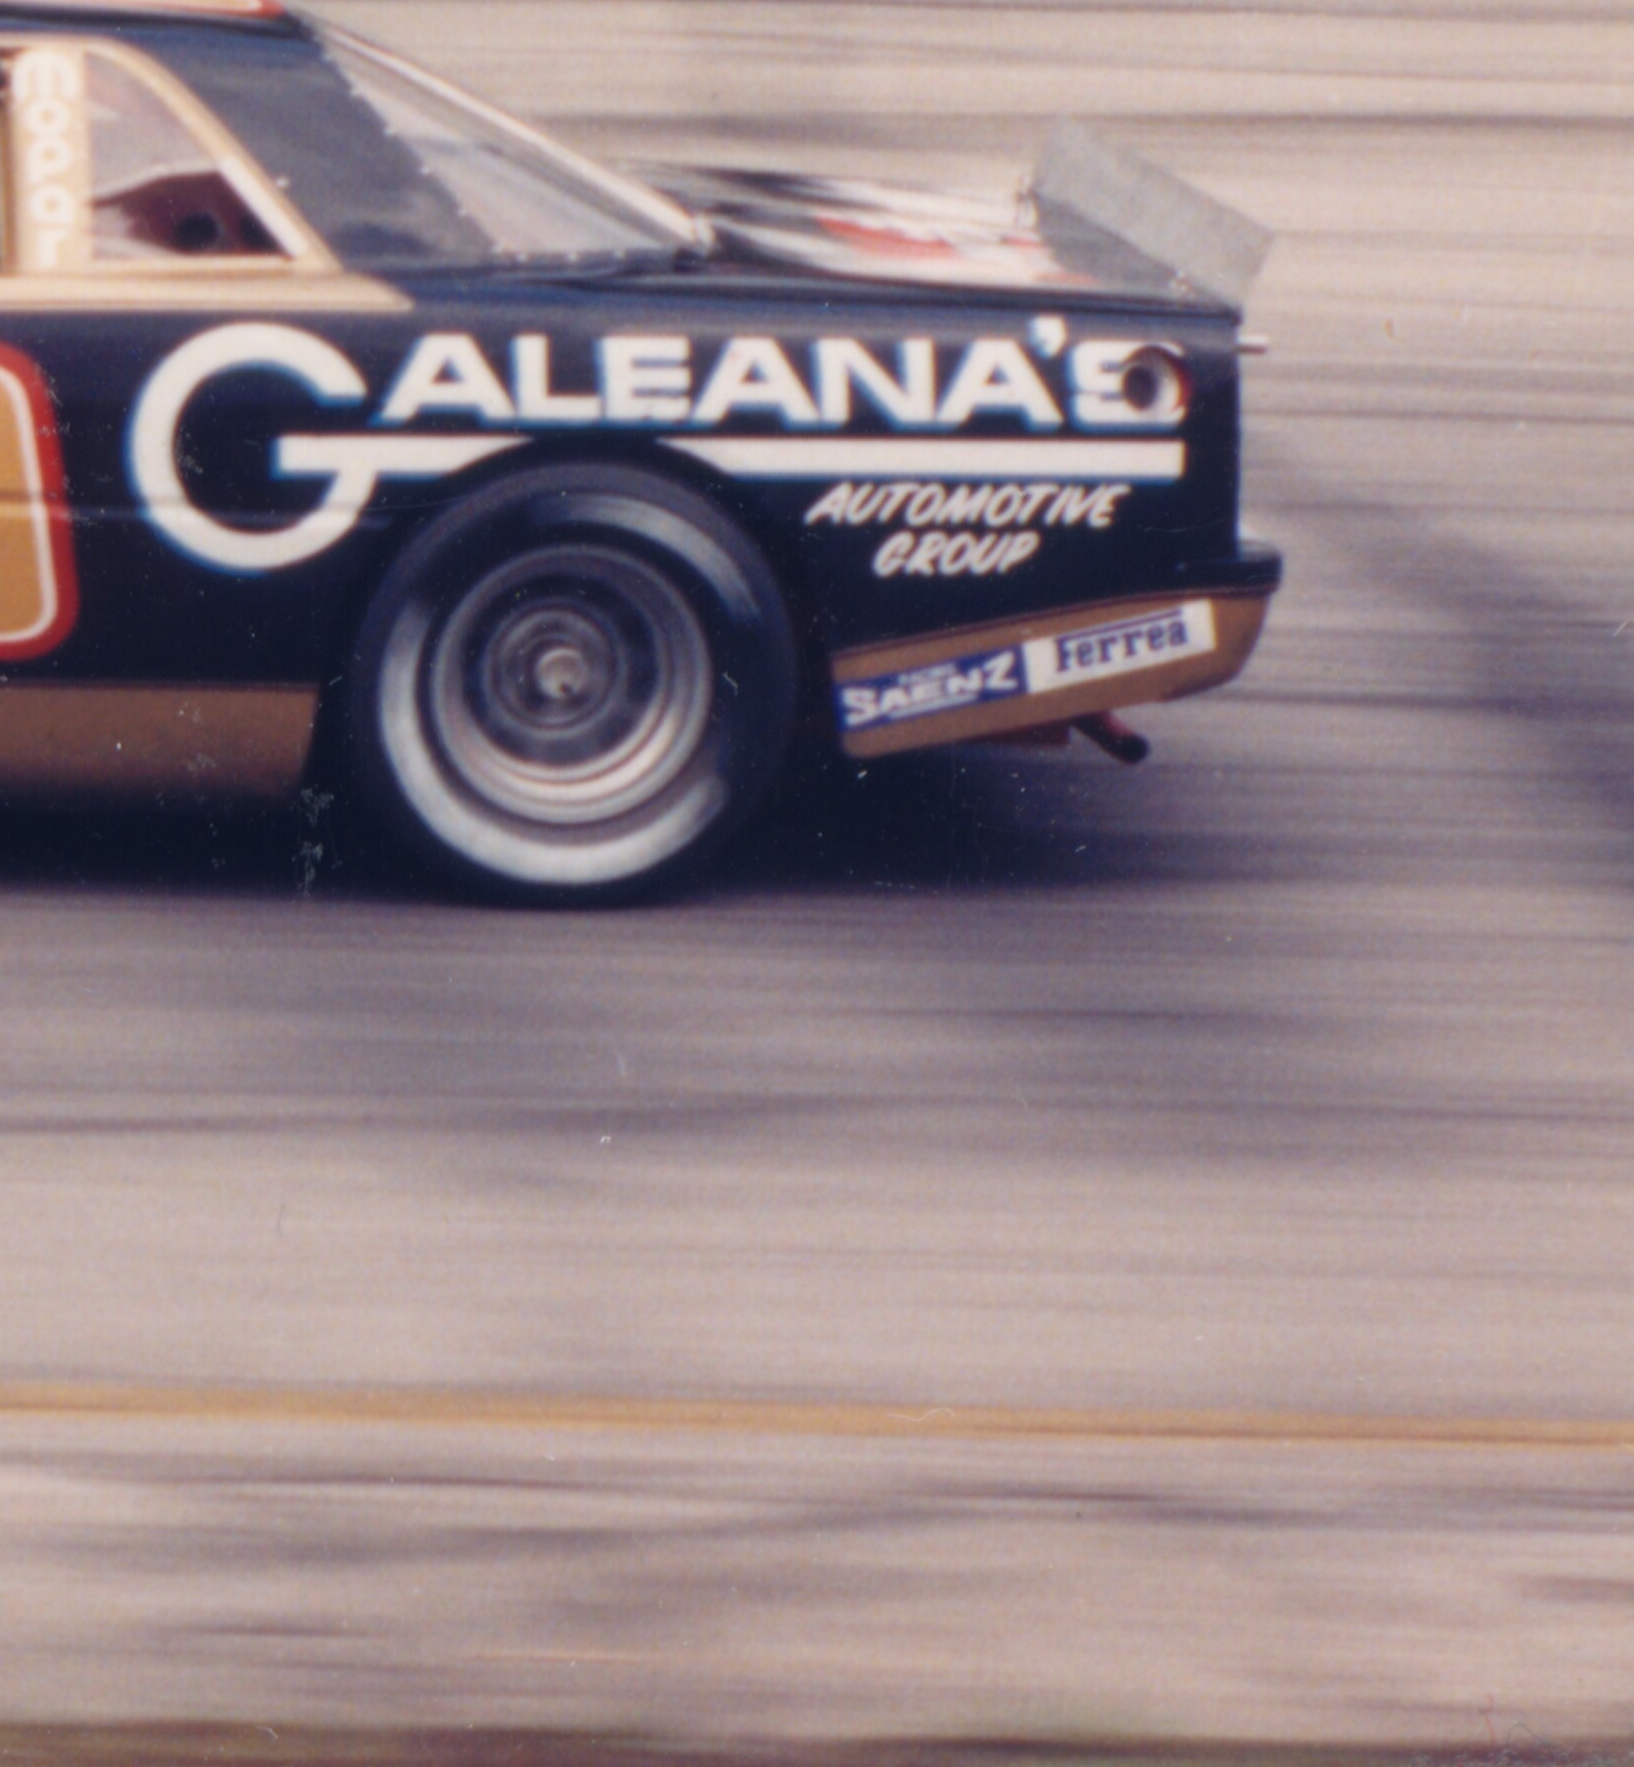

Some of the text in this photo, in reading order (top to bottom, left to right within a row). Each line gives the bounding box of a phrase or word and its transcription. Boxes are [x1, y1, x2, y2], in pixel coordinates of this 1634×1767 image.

[130, 314, 1187, 571] GALEANA'S
[804, 481, 1132, 529] AUTOMOTIVE
[871, 531, 1040, 577] GROUP
[1054, 610, 1189, 675] Ferrea
